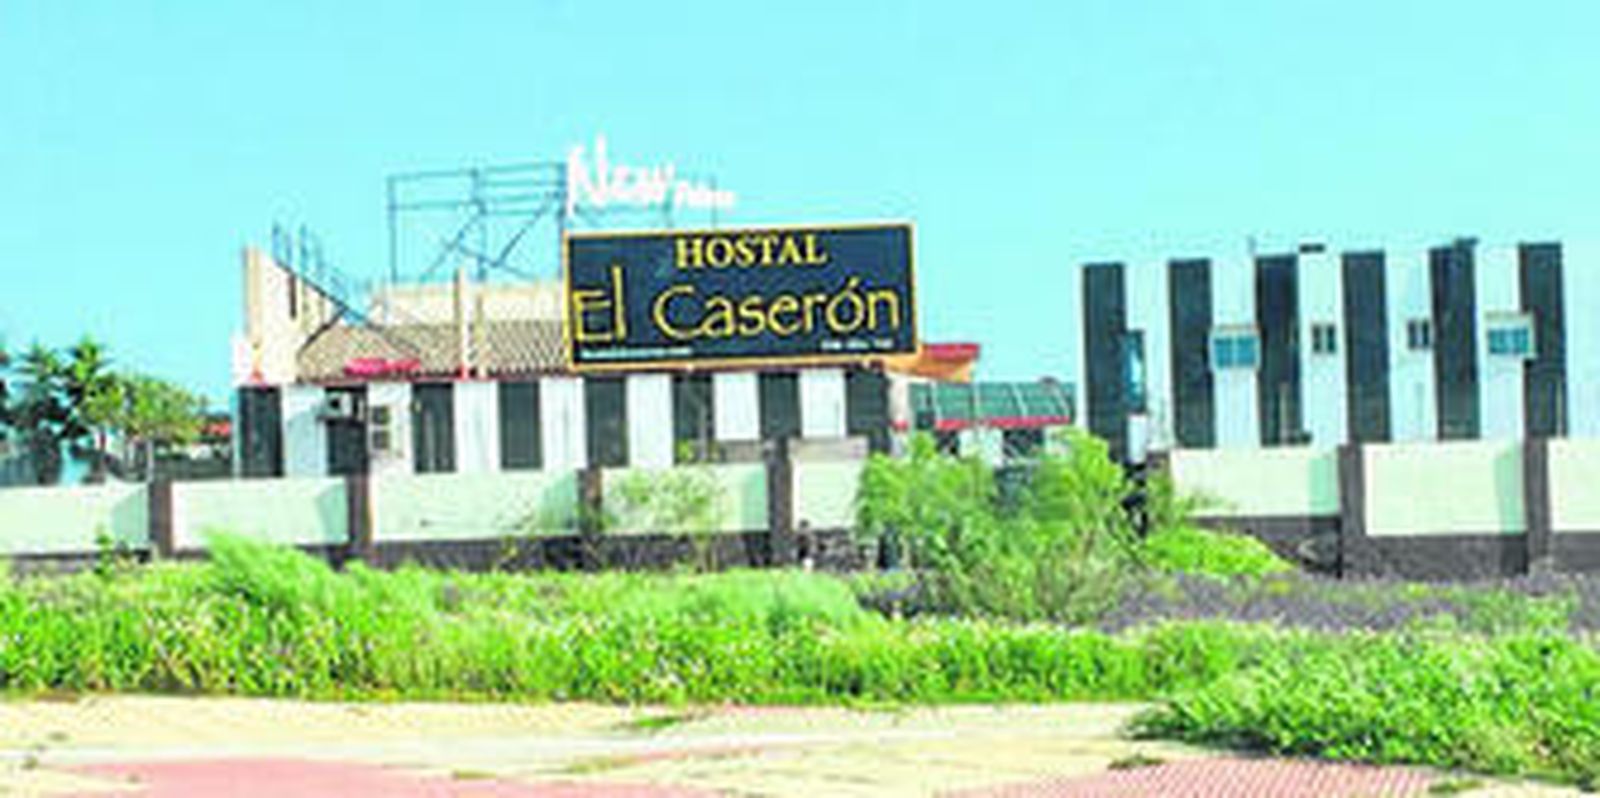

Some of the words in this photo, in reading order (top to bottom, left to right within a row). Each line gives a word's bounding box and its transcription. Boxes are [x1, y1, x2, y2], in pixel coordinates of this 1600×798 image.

[567, 133, 675, 218] New
[676, 234, 827, 268] HOSTAL
[573, 265, 627, 341] El
[653, 276, 899, 339] Caserón
